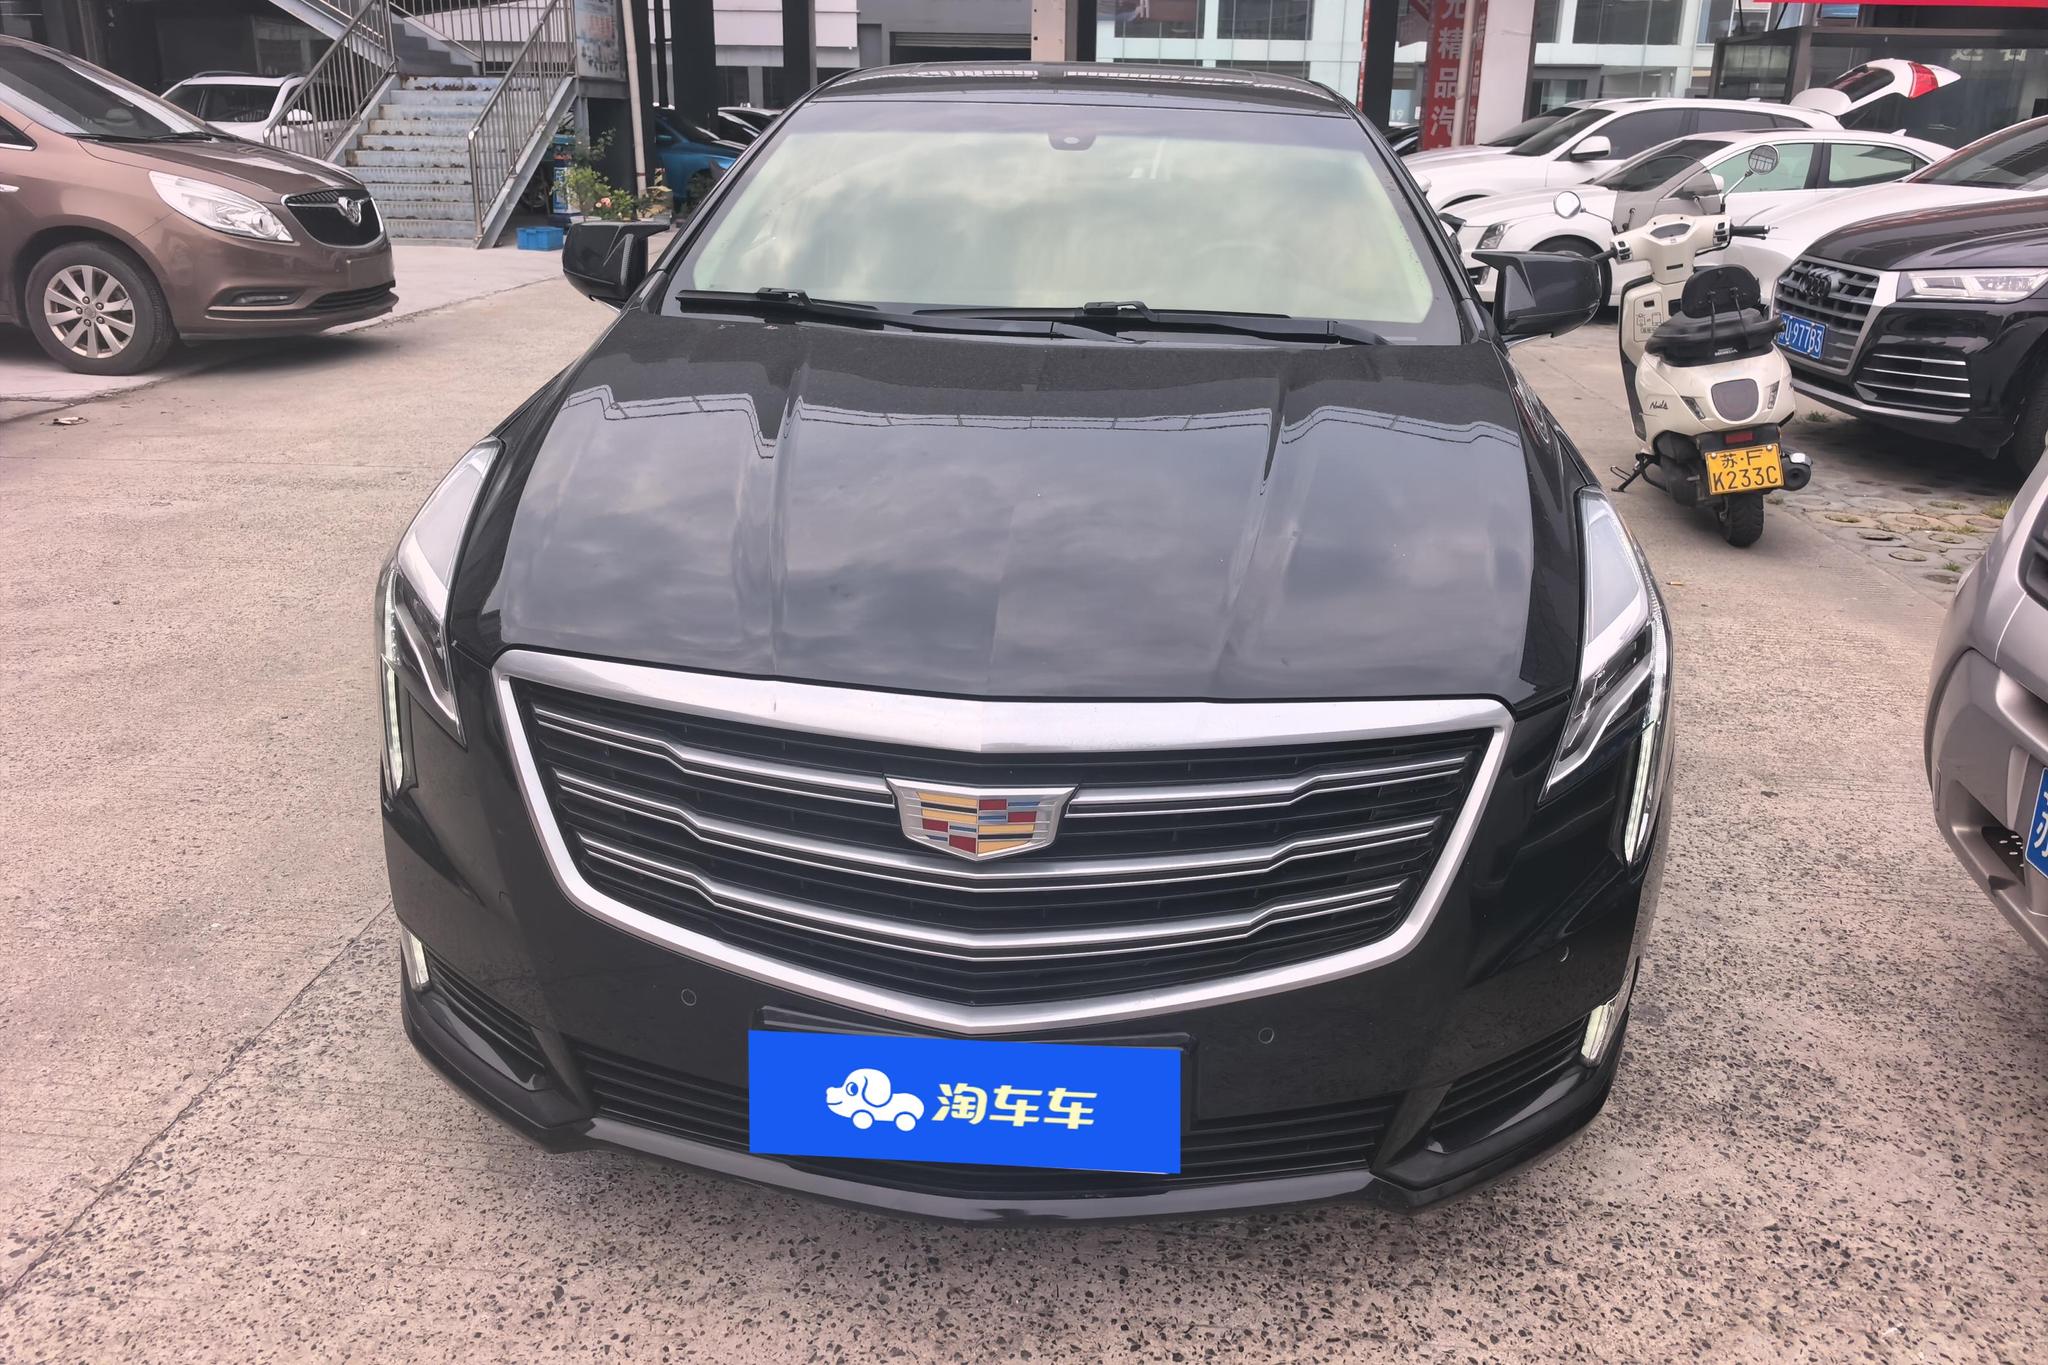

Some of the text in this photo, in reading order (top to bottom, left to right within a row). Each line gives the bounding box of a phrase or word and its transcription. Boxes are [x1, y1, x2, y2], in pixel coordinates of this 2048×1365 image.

[1431, 0, 1465, 148] 精品汽
[1712, 466, 1778, 491] K233C
